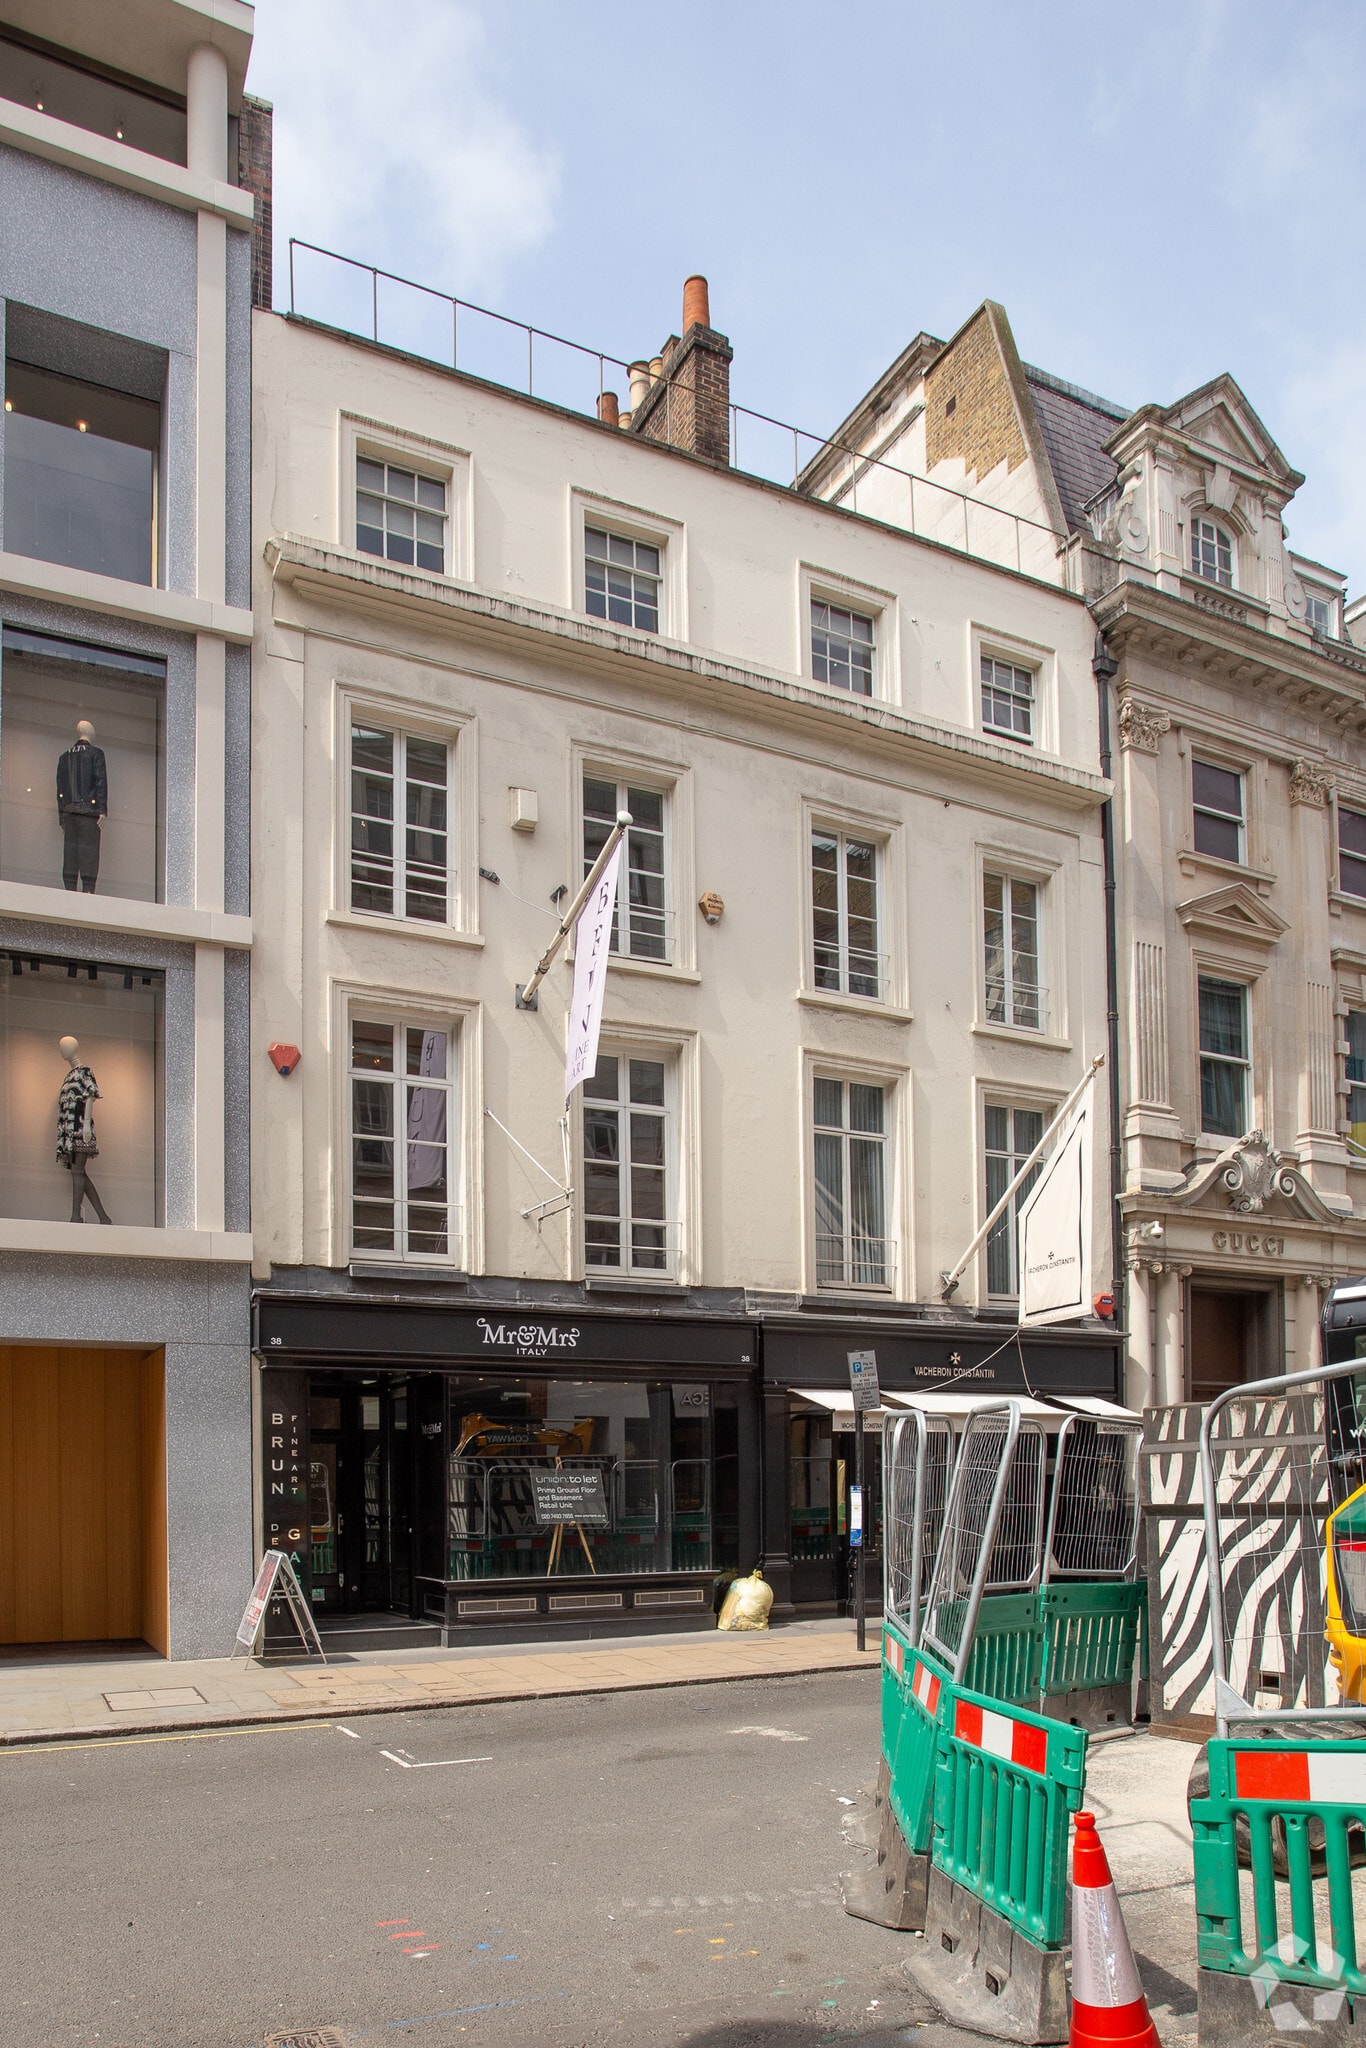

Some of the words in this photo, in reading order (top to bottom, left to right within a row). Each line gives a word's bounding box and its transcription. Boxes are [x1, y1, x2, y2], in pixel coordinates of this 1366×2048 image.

[1212, 1231, 1285, 1256] GUCCI
[271, 1337, 281, 1345] 38
[476, 1318, 580, 1347] Mr&Mrs
[914, 1366, 952, 1377] VACHERON
[953, 1368, 995, 1378] CONSTANTIN
[271, 1413, 284, 1495] BRUN
[582, 1475, 598, 1484] let
